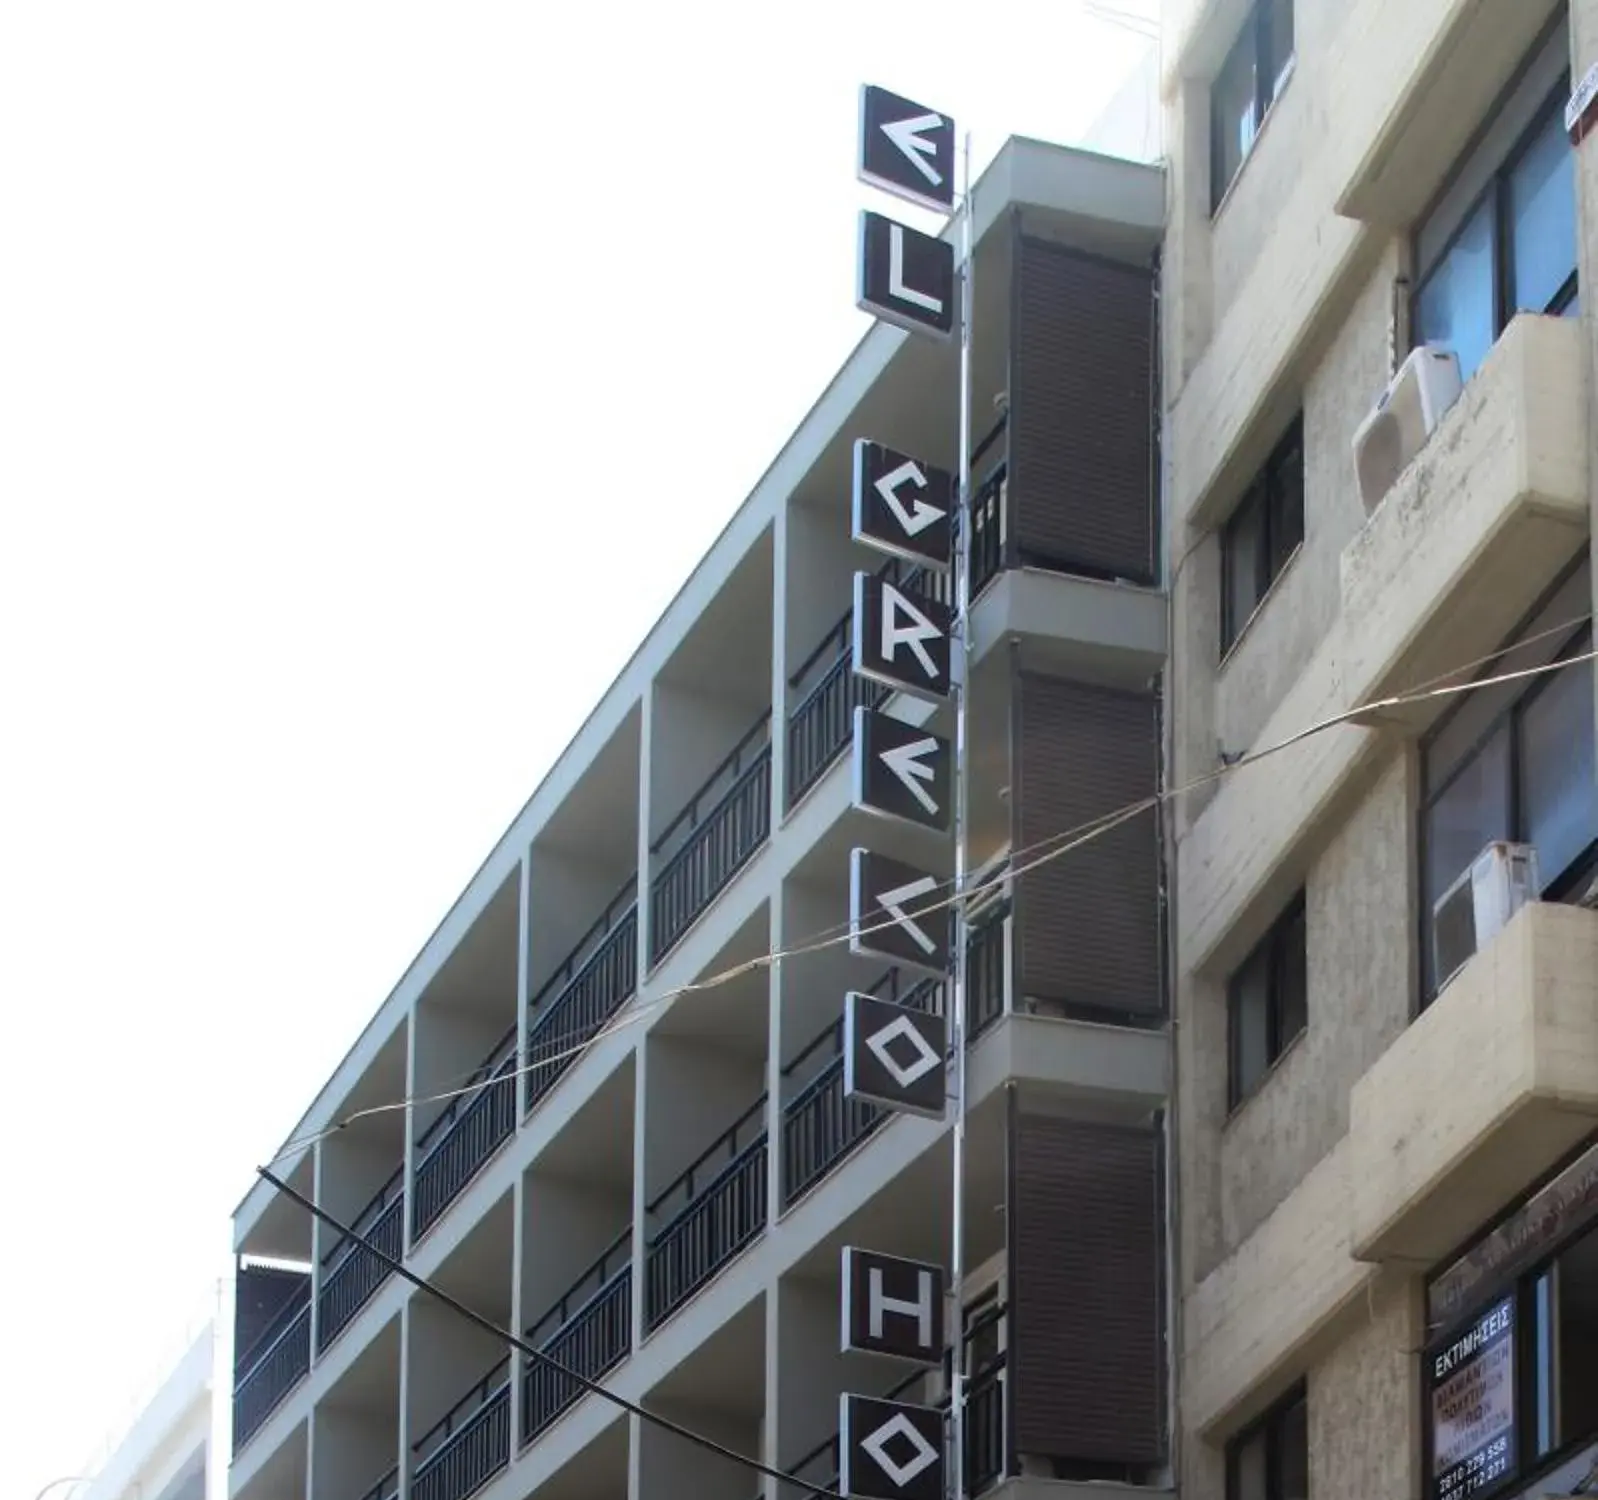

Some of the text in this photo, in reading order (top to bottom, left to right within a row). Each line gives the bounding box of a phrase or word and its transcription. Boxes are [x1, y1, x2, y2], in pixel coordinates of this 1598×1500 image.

[879, 112, 943, 312] EL
[873, 459, 947, 1088] GRECO
[1434, 1303, 1510, 1379] ΕΚΤΙΜΗΣΕΙΣ
